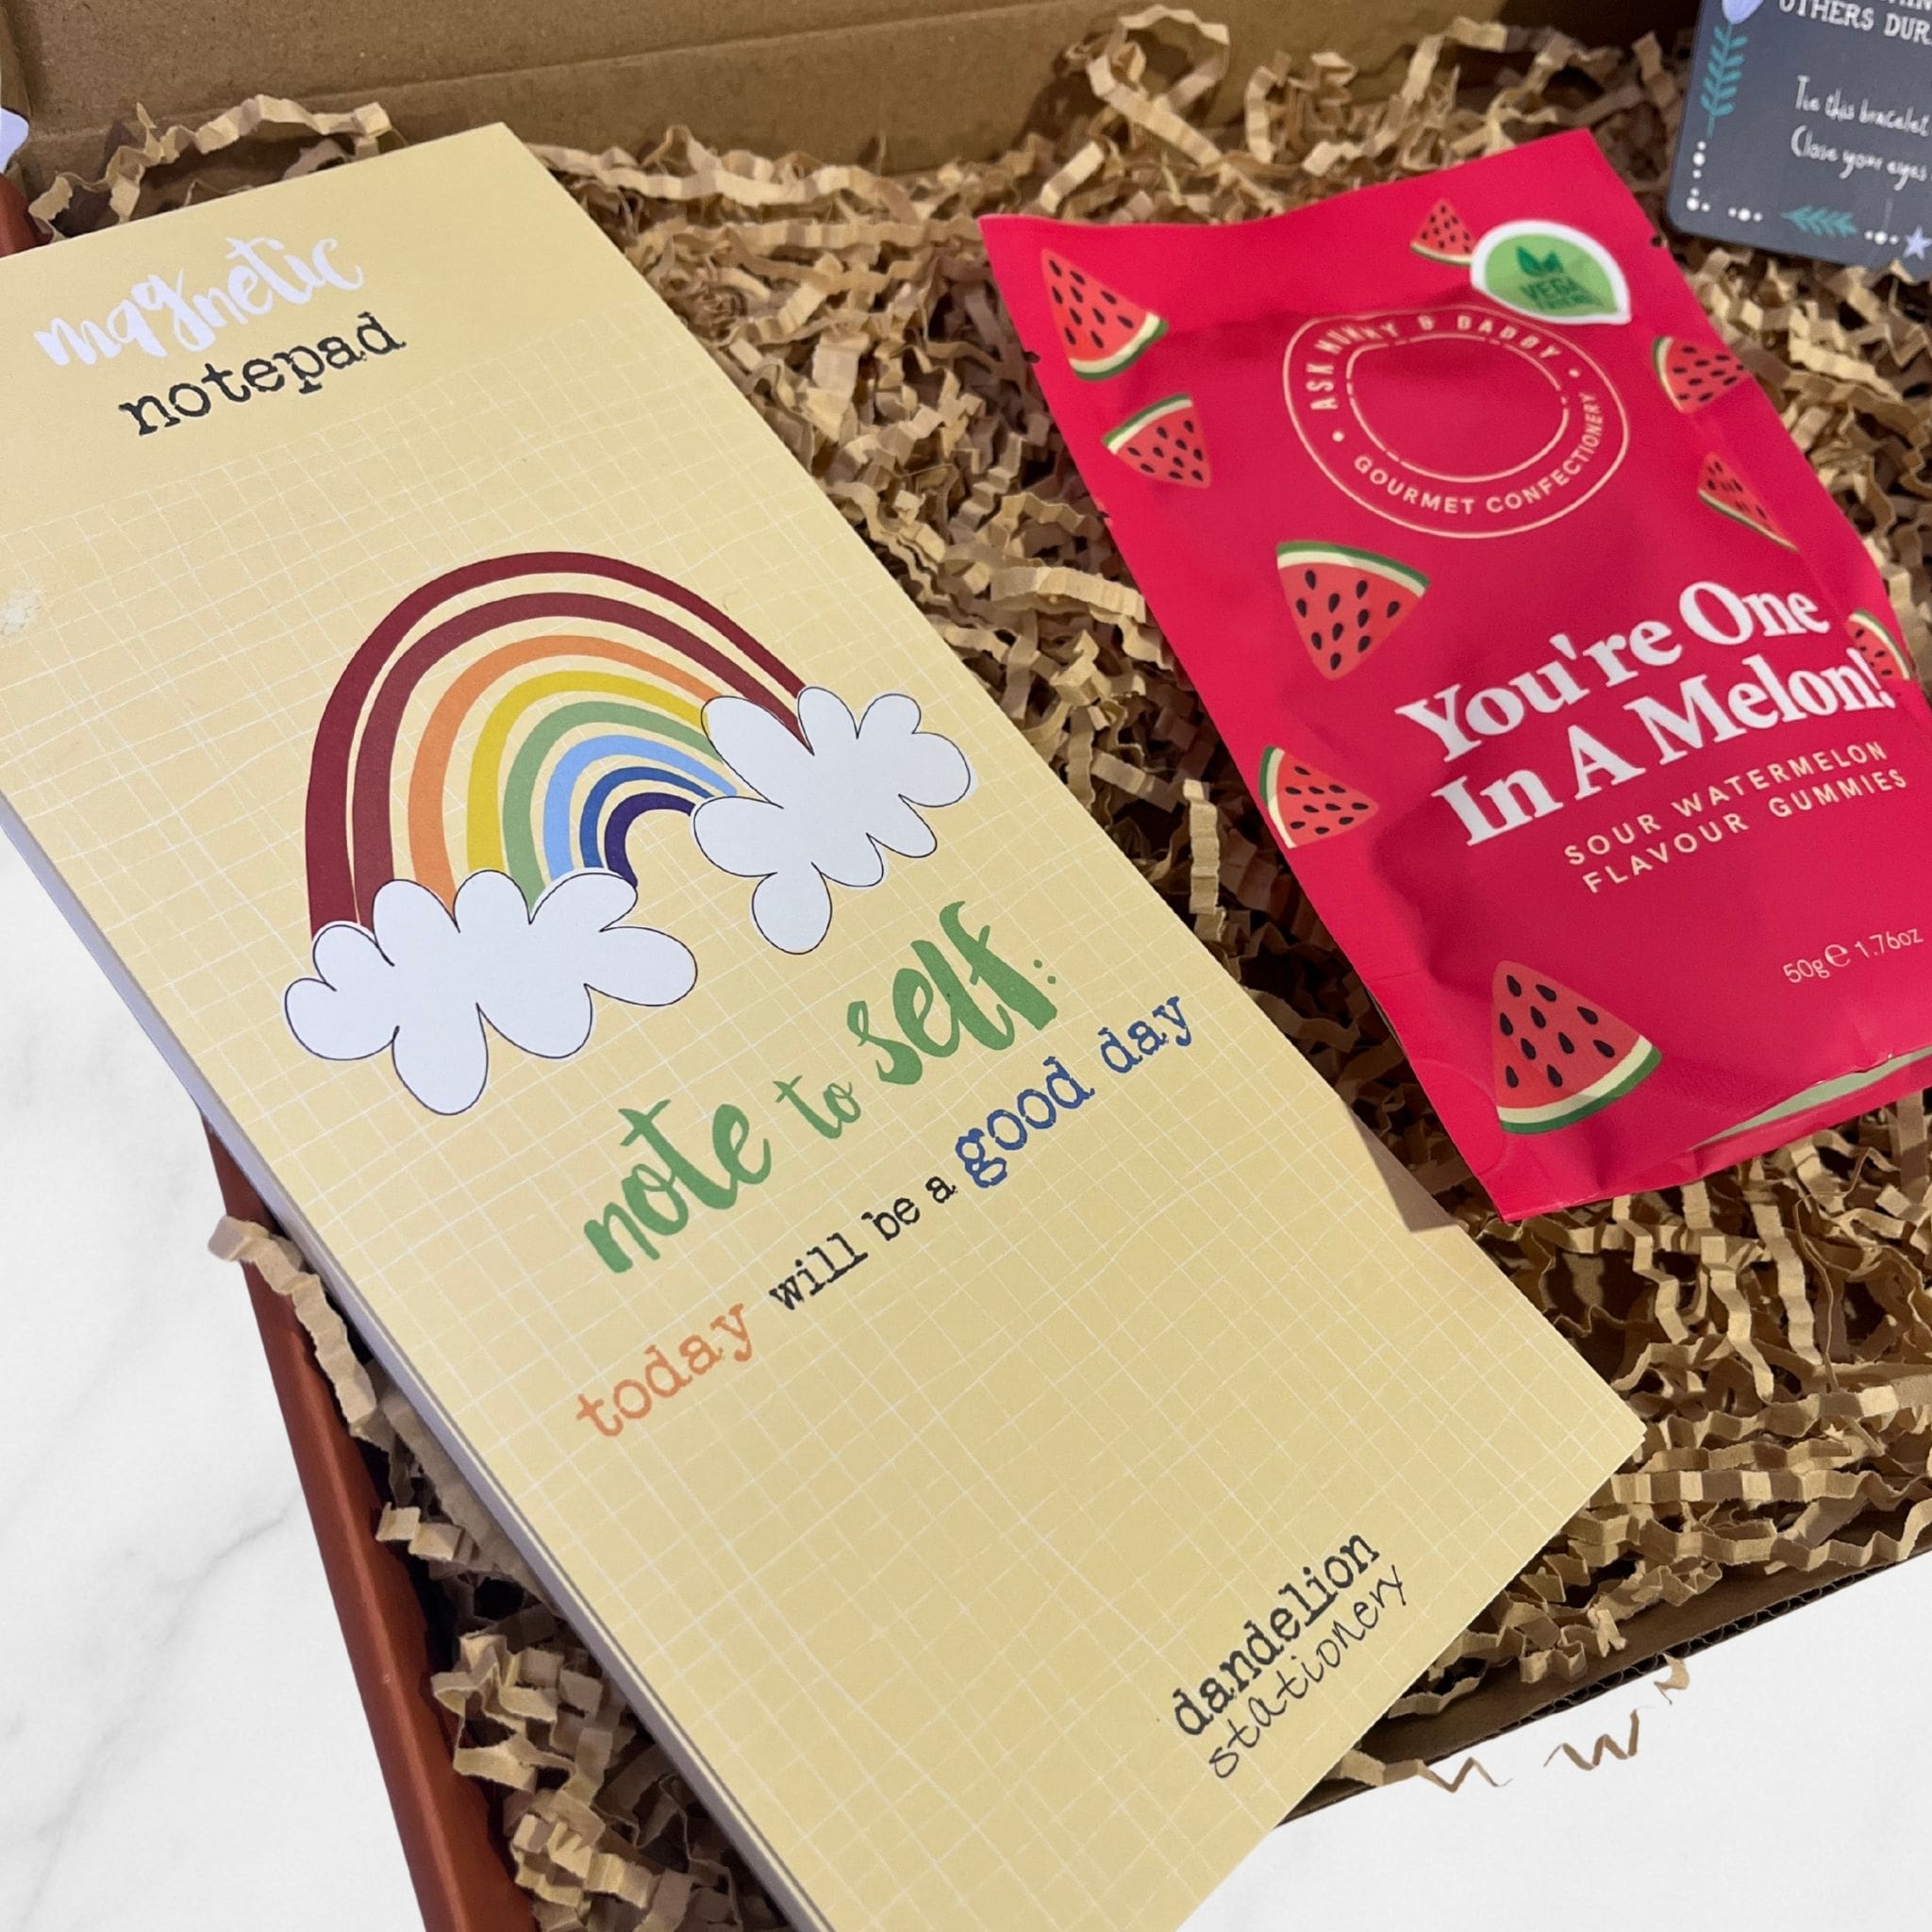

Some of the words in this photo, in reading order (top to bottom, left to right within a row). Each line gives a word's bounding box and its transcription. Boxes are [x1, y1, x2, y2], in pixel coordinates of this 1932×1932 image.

[1884, 12, 1932, 46] DUR
[1790, 125, 1839, 162] Close
[1839, 149, 1884, 180] your
[1887, 160, 1927, 192] eyes
[1796, 75, 1821, 111] Tie
[1824, 87, 1856, 122] this
[1858, 97, 1929, 137] bracelet
[34, 237, 365, 367] magnetic
[118, 310, 408, 436] notepad
[1306, 362, 1339, 410] ASK
[1354, 455, 1475, 515] GOURMET
[1485, 391, 1605, 514] CONFECTIONERY
[1394, 618, 1685, 763] You're
[1678, 580, 1831, 646] One
[1430, 766, 1564, 847] In
[1564, 724, 1647, 801] A
[1624, 646, 1897, 766] Melon!
[1563, 812, 1662, 866] SOUR
[1671, 740, 1889, 819] WATERMELON
[1581, 811, 1749, 894] FLAVOUR
[1768, 767, 1908, 819] GUMMIES
[1854, 927, 1924, 959] 1.76oz
[583, 1098, 773, 1274] note
[772, 1074, 862, 1140] to
[846, 899, 1059, 1086] self:
[575, 1302, 754, 1437] today
[768, 1232, 870, 1311] will
[860, 1193, 922, 1242] be
[924, 1174, 958, 1204] a
[954, 1056, 1096, 1190] good
[1097, 995, 1193, 1074] day
[1172, 1534, 1381, 1736] dandelion
[1208, 1563, 1407, 1779] stationery
